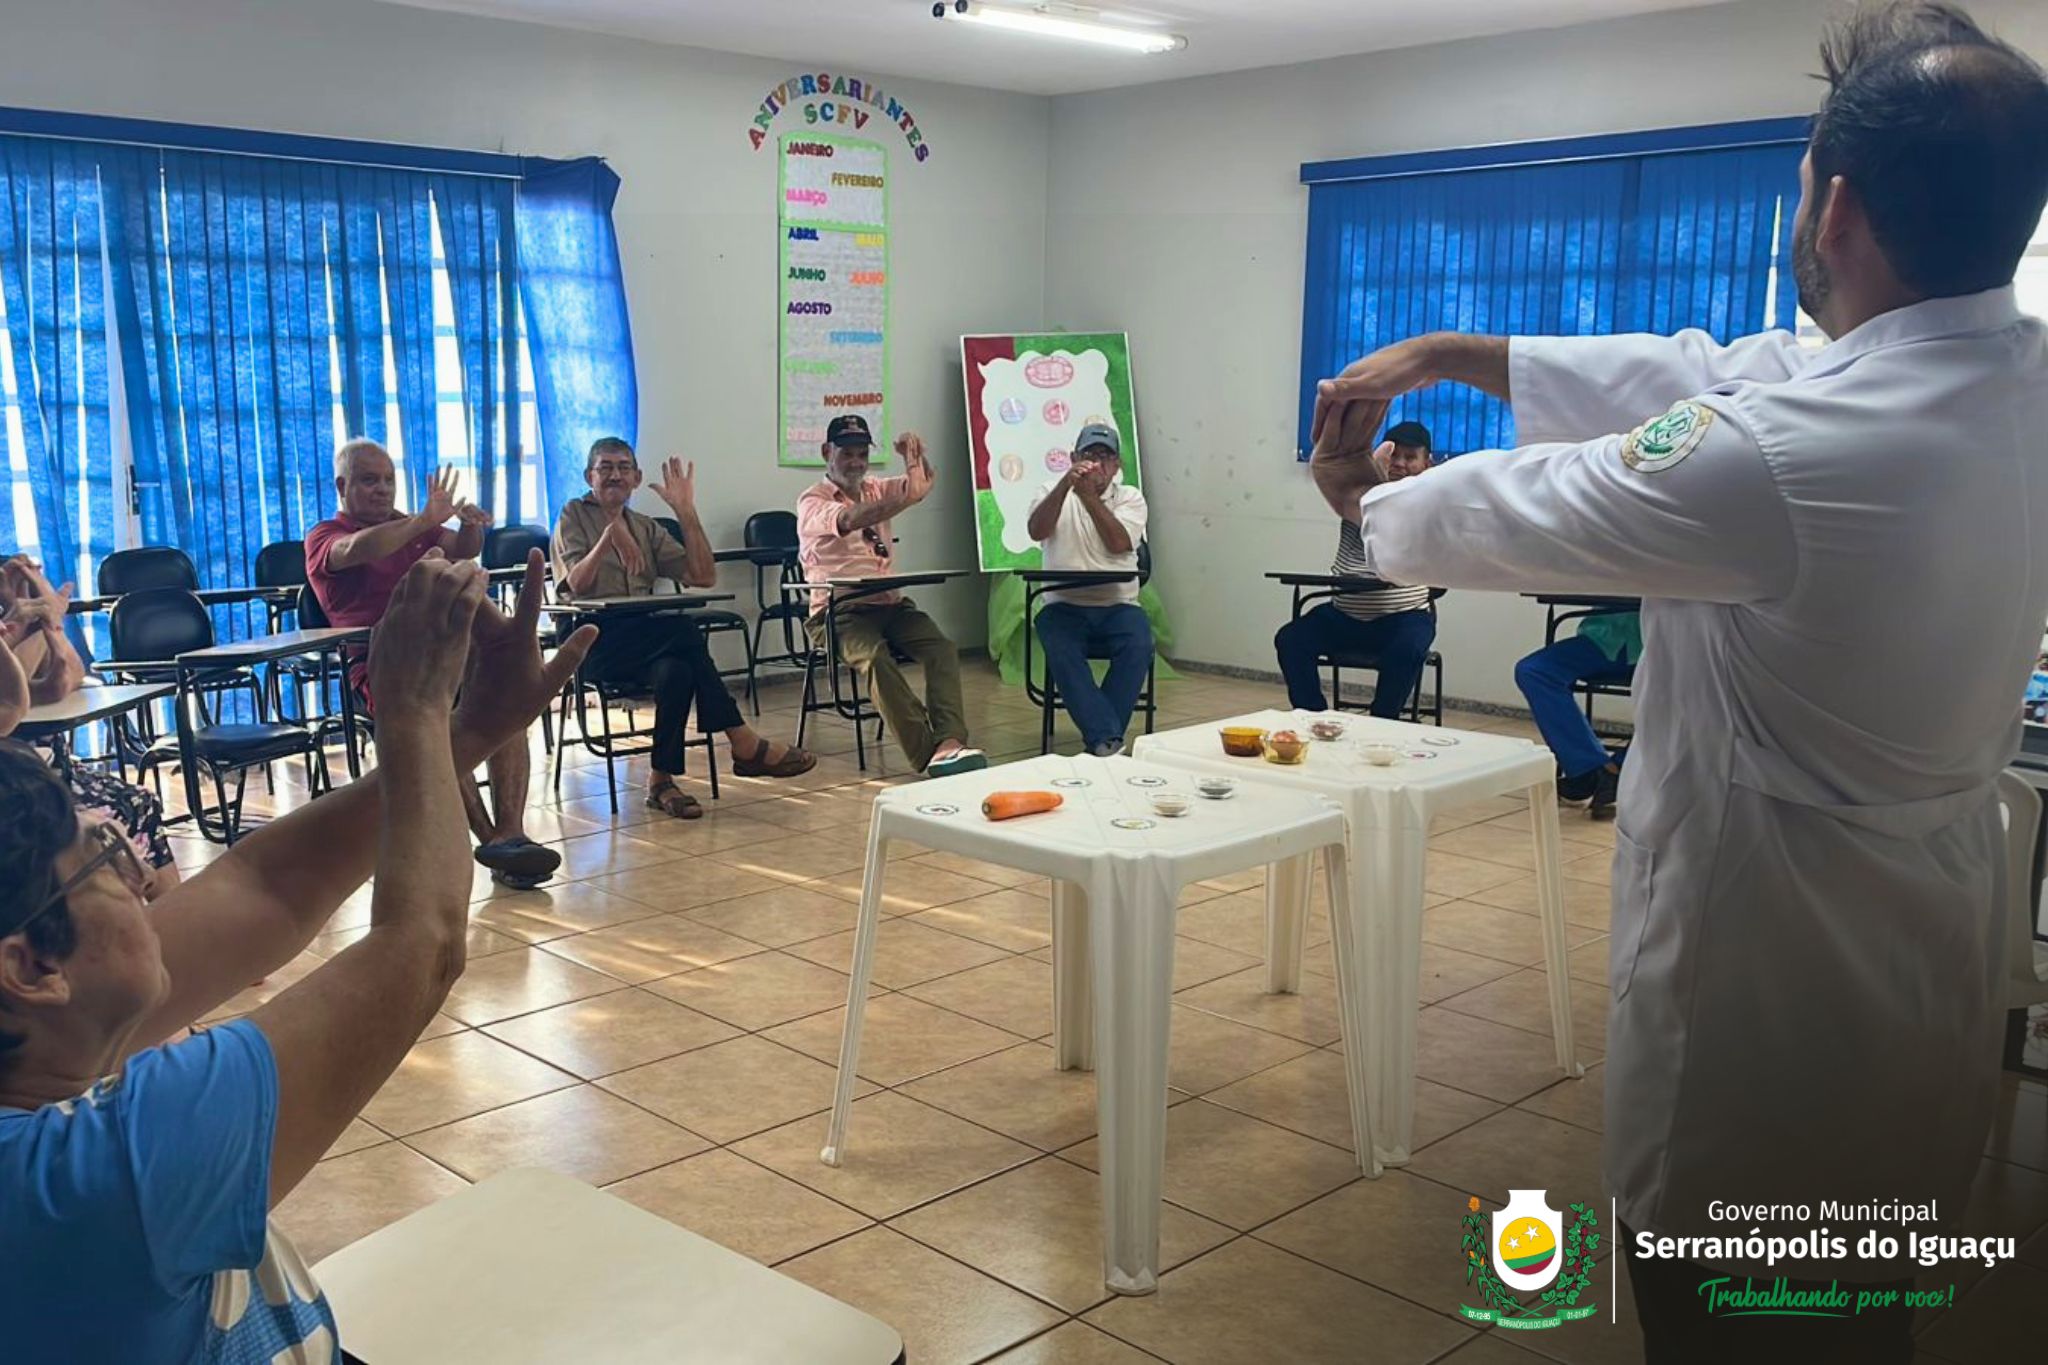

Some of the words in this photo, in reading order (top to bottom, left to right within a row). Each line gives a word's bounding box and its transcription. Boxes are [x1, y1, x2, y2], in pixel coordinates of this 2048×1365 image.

[748, 73, 930, 163] ANIVERSARIANTES
[803, 102, 869, 130] SCFV
[786, 141, 834, 157] JANEIRO
[831, 172, 884, 189] FEVEREIRO
[786, 188, 828, 206] MARÇO
[788, 226, 820, 241] ABRIL
[788, 266, 826, 281] JUNHO
[787, 301, 832, 315] AGOSTO
[823, 392, 884, 407] NOVEMBRO
